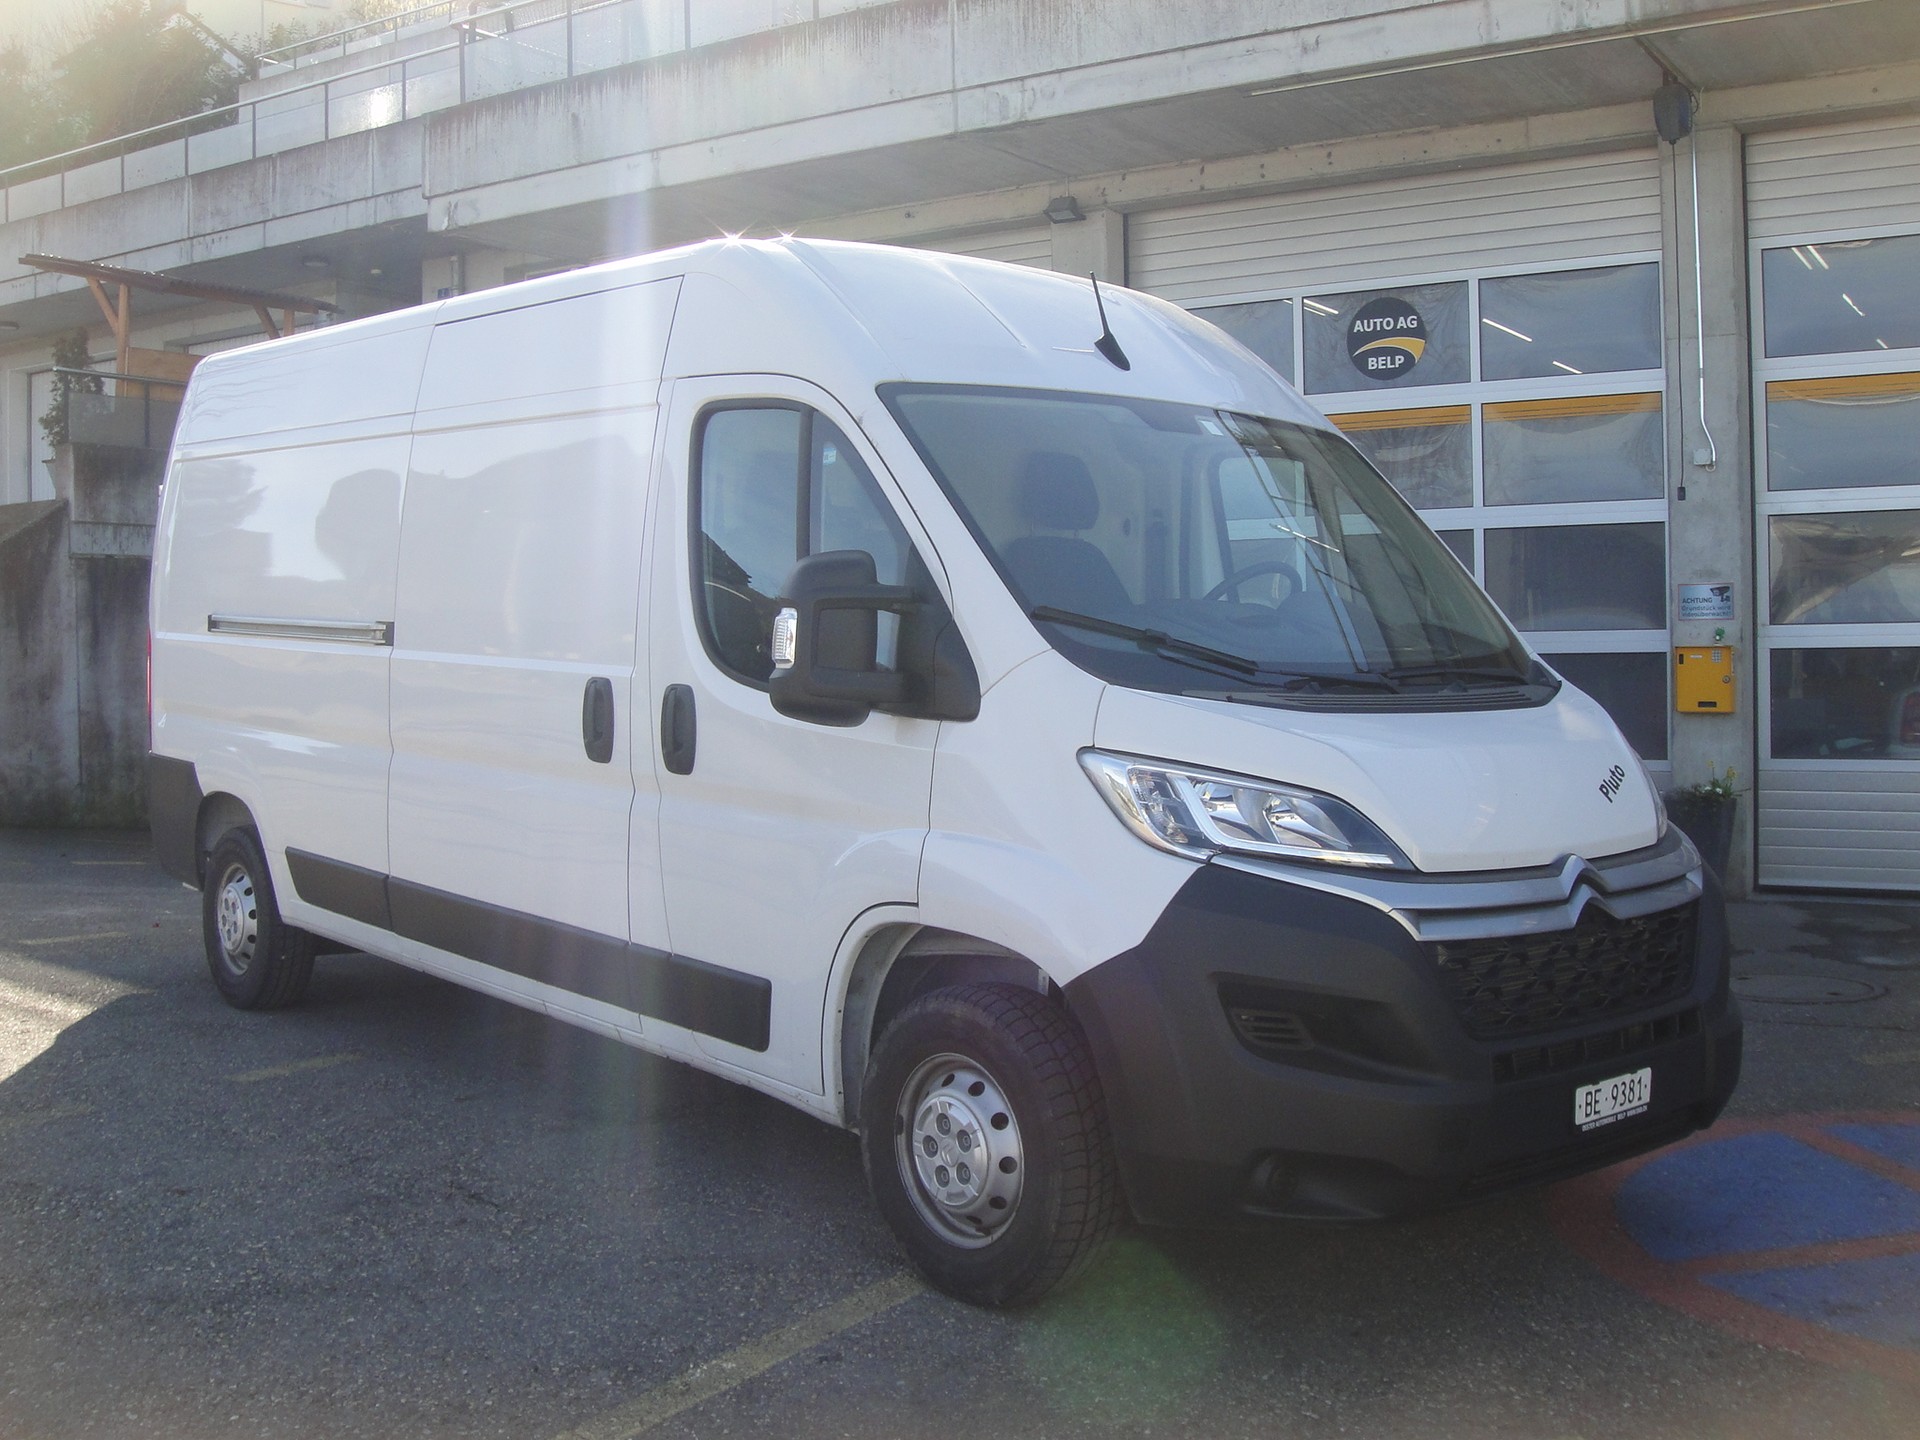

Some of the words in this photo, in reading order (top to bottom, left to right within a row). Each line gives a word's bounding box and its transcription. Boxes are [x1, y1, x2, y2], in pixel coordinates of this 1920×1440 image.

[1353, 317, 1394, 333] AUTO
[1396, 315, 1418, 330] AG
[1367, 355, 1405, 370] BELP
[1598, 764, 1626, 804] Pluto
